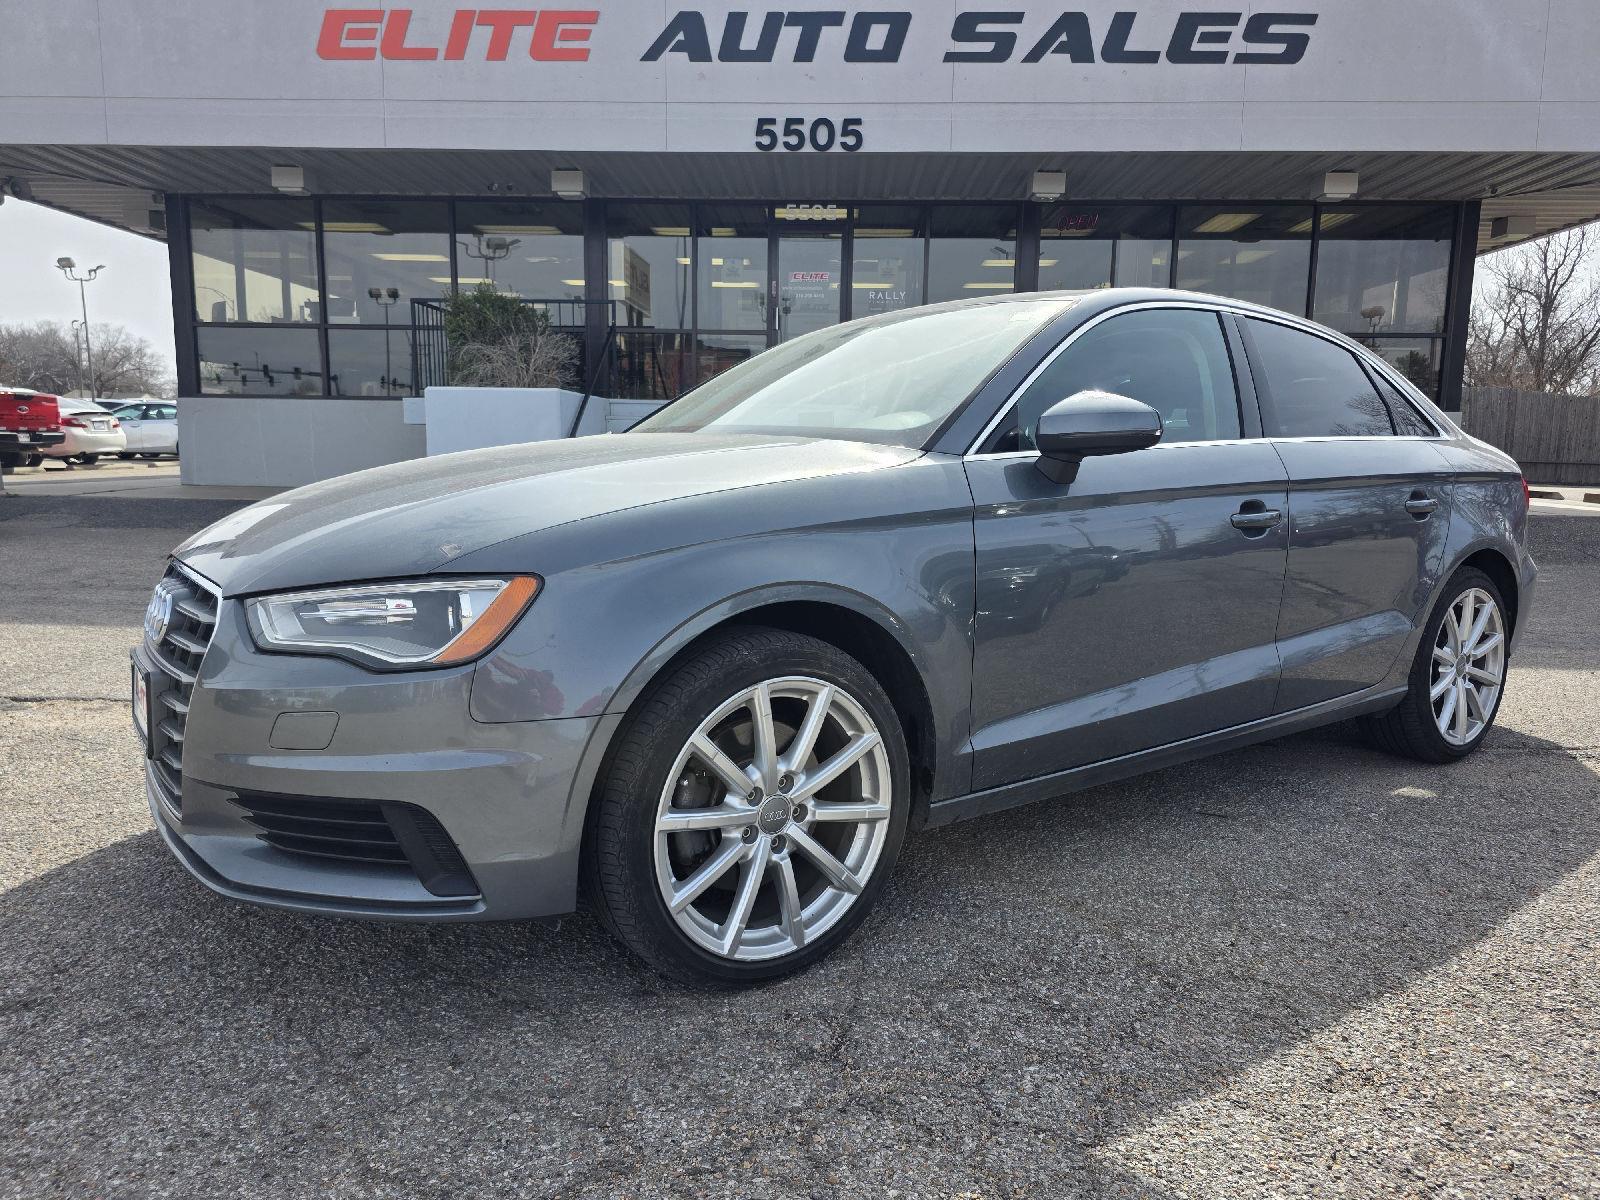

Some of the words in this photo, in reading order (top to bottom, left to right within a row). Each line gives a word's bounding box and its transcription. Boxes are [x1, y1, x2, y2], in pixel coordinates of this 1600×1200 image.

[316, 9, 600, 61] ELITE
[639, 10, 912, 62] AUTO
[942, 11, 1319, 64] SALES
[755, 117, 864, 152] 5505
[785, 204, 837, 221] 5505
[793, 272, 830, 281] ELITE
[869, 291, 906, 300] RALLY
